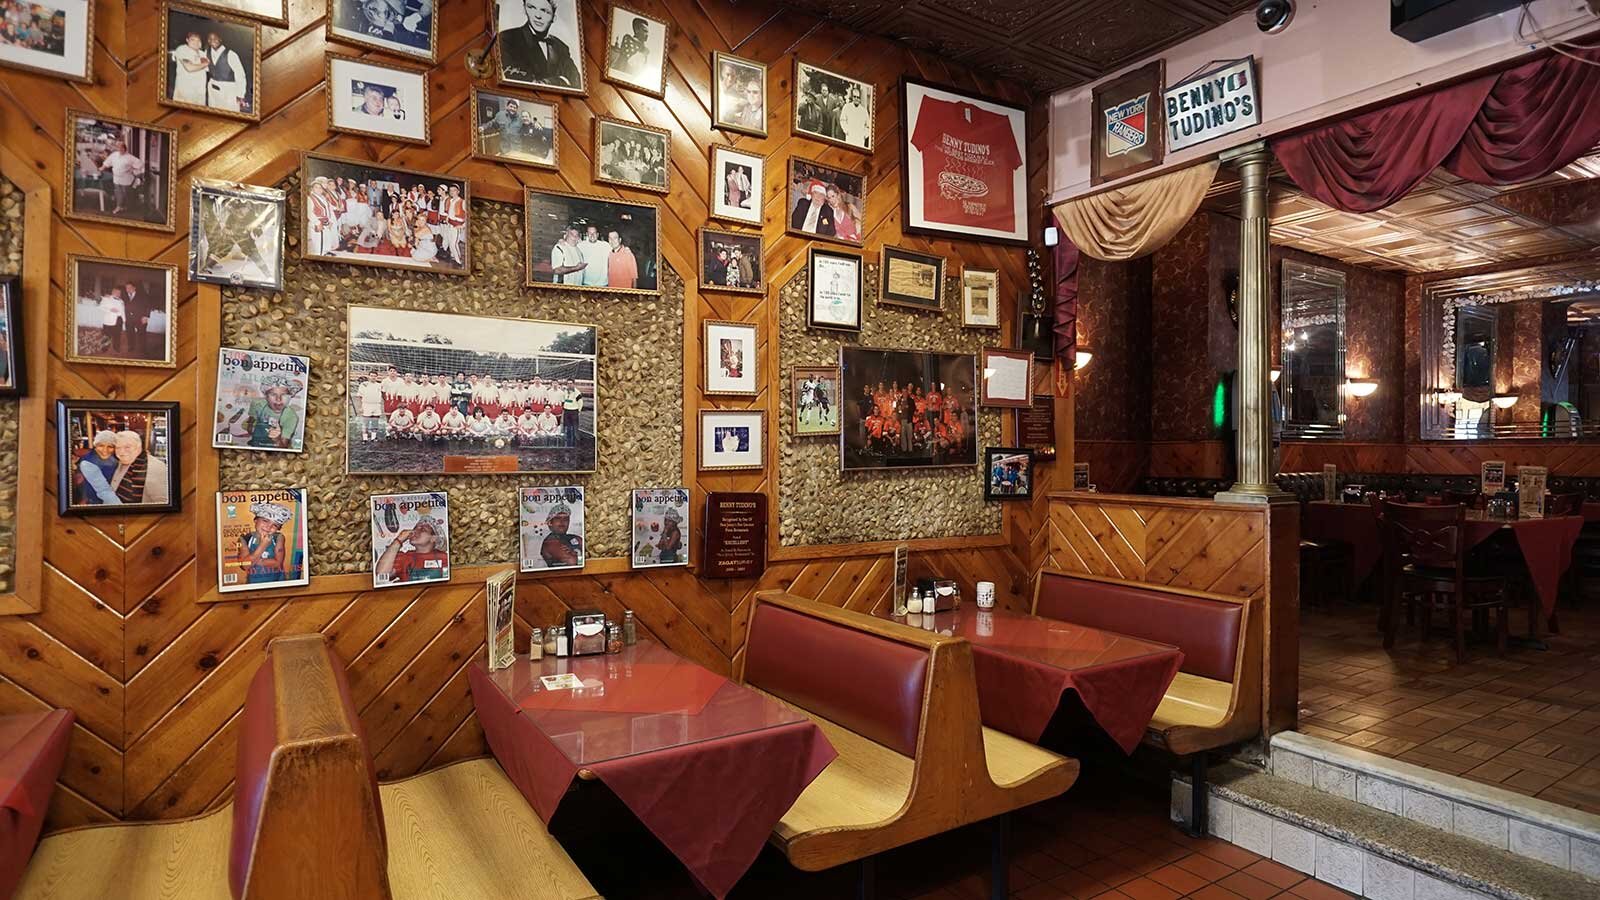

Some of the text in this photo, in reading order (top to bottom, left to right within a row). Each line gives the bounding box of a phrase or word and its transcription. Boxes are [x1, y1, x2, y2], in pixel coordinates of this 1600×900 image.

[1166, 77, 1226, 118] BENNY
[1108, 101, 1145, 123] NEW YORK
[1169, 94, 1253, 141] TUDINO'S
[942, 132, 963, 151] BENNY
[1112, 121, 1144, 146] RANGERS
[223, 354, 251, 368] bon
[222, 492, 246, 503] bon
[374, 500, 397, 511] bon
[522, 492, 541, 503] bon
